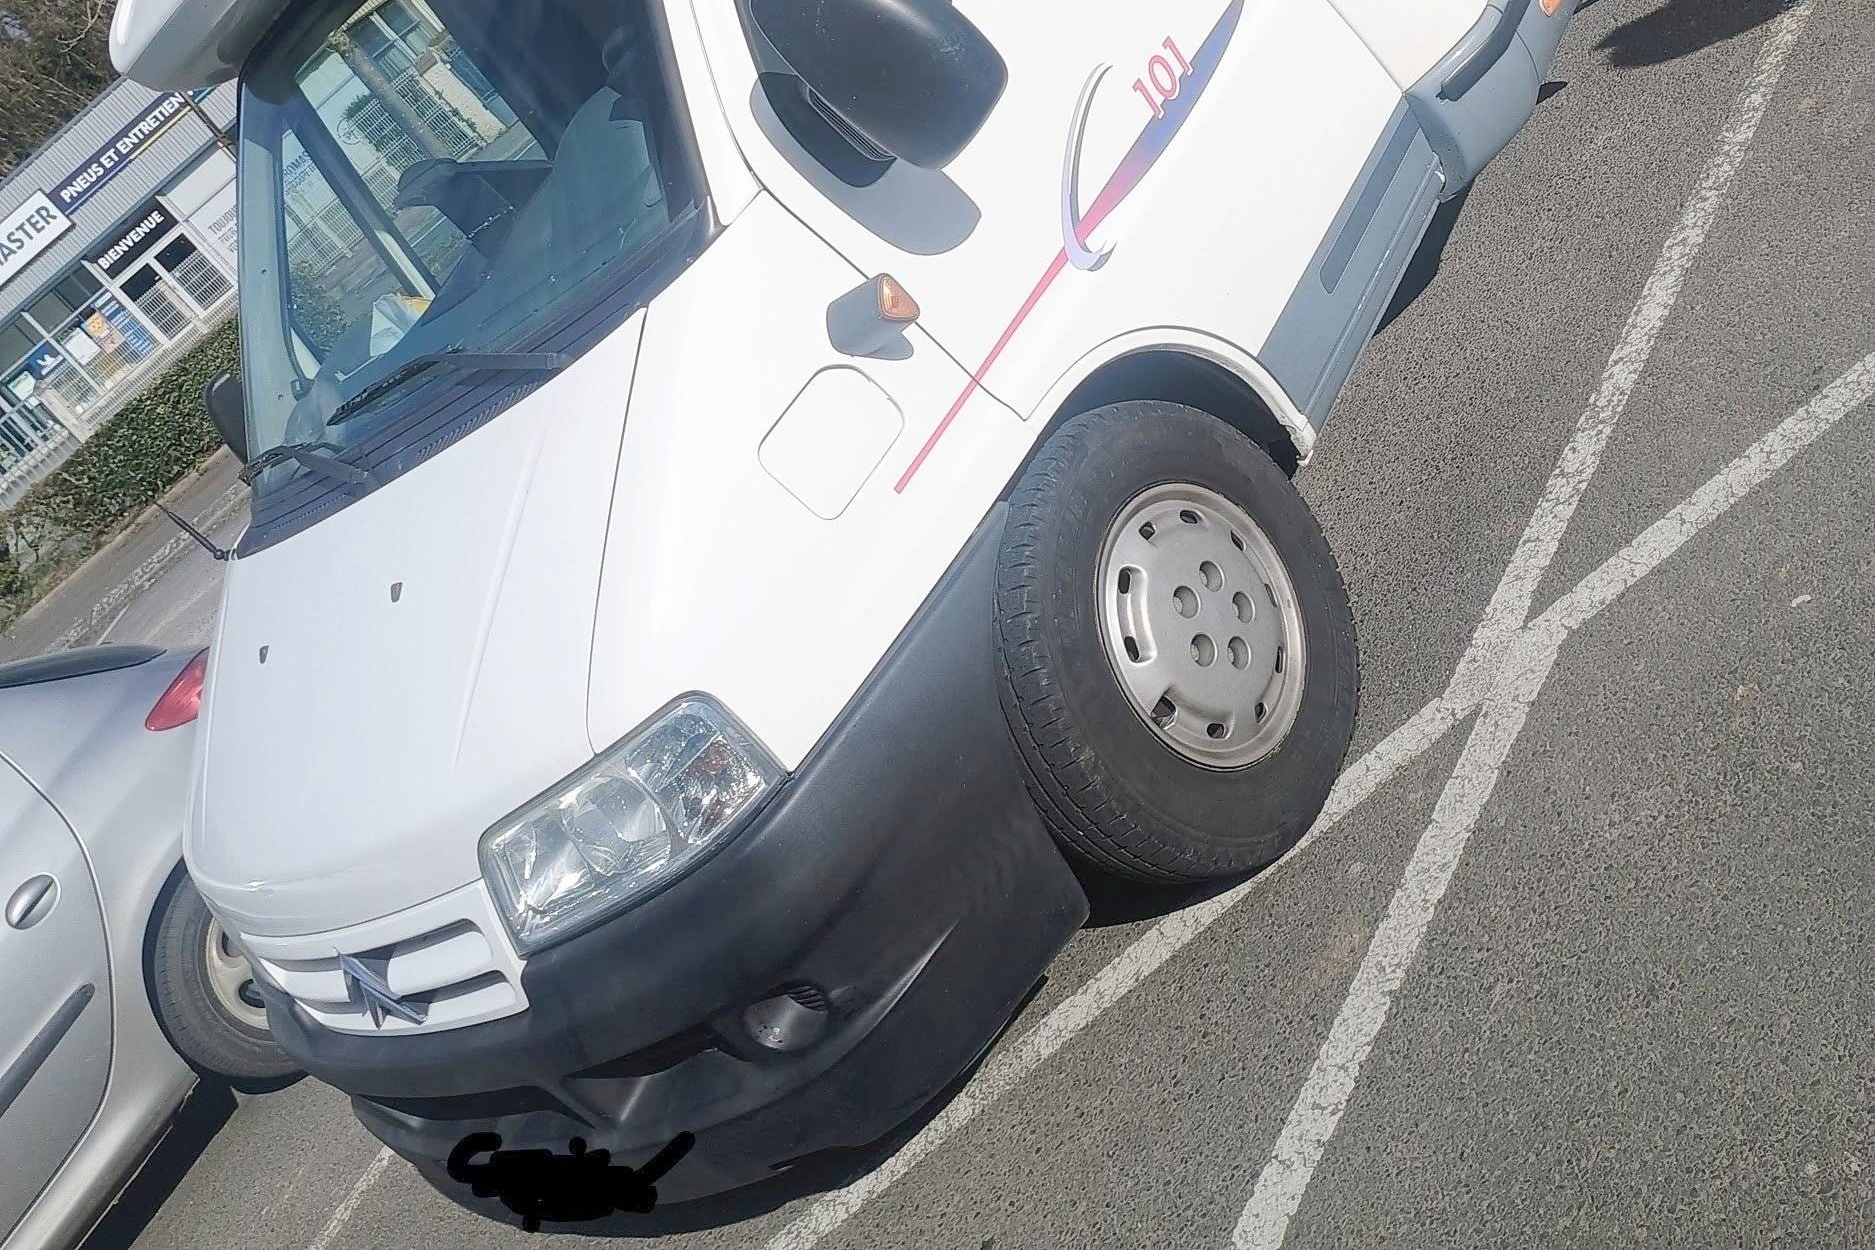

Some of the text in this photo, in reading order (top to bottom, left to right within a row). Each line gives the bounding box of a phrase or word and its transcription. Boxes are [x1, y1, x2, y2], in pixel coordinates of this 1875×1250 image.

[1131, 35, 1191, 117] 101
[60, 92, 186, 203] PNEUS ET ENTRETIEN
[0, 206, 57, 266] ASTER
[97, 210, 165, 270] BIENVENUE
